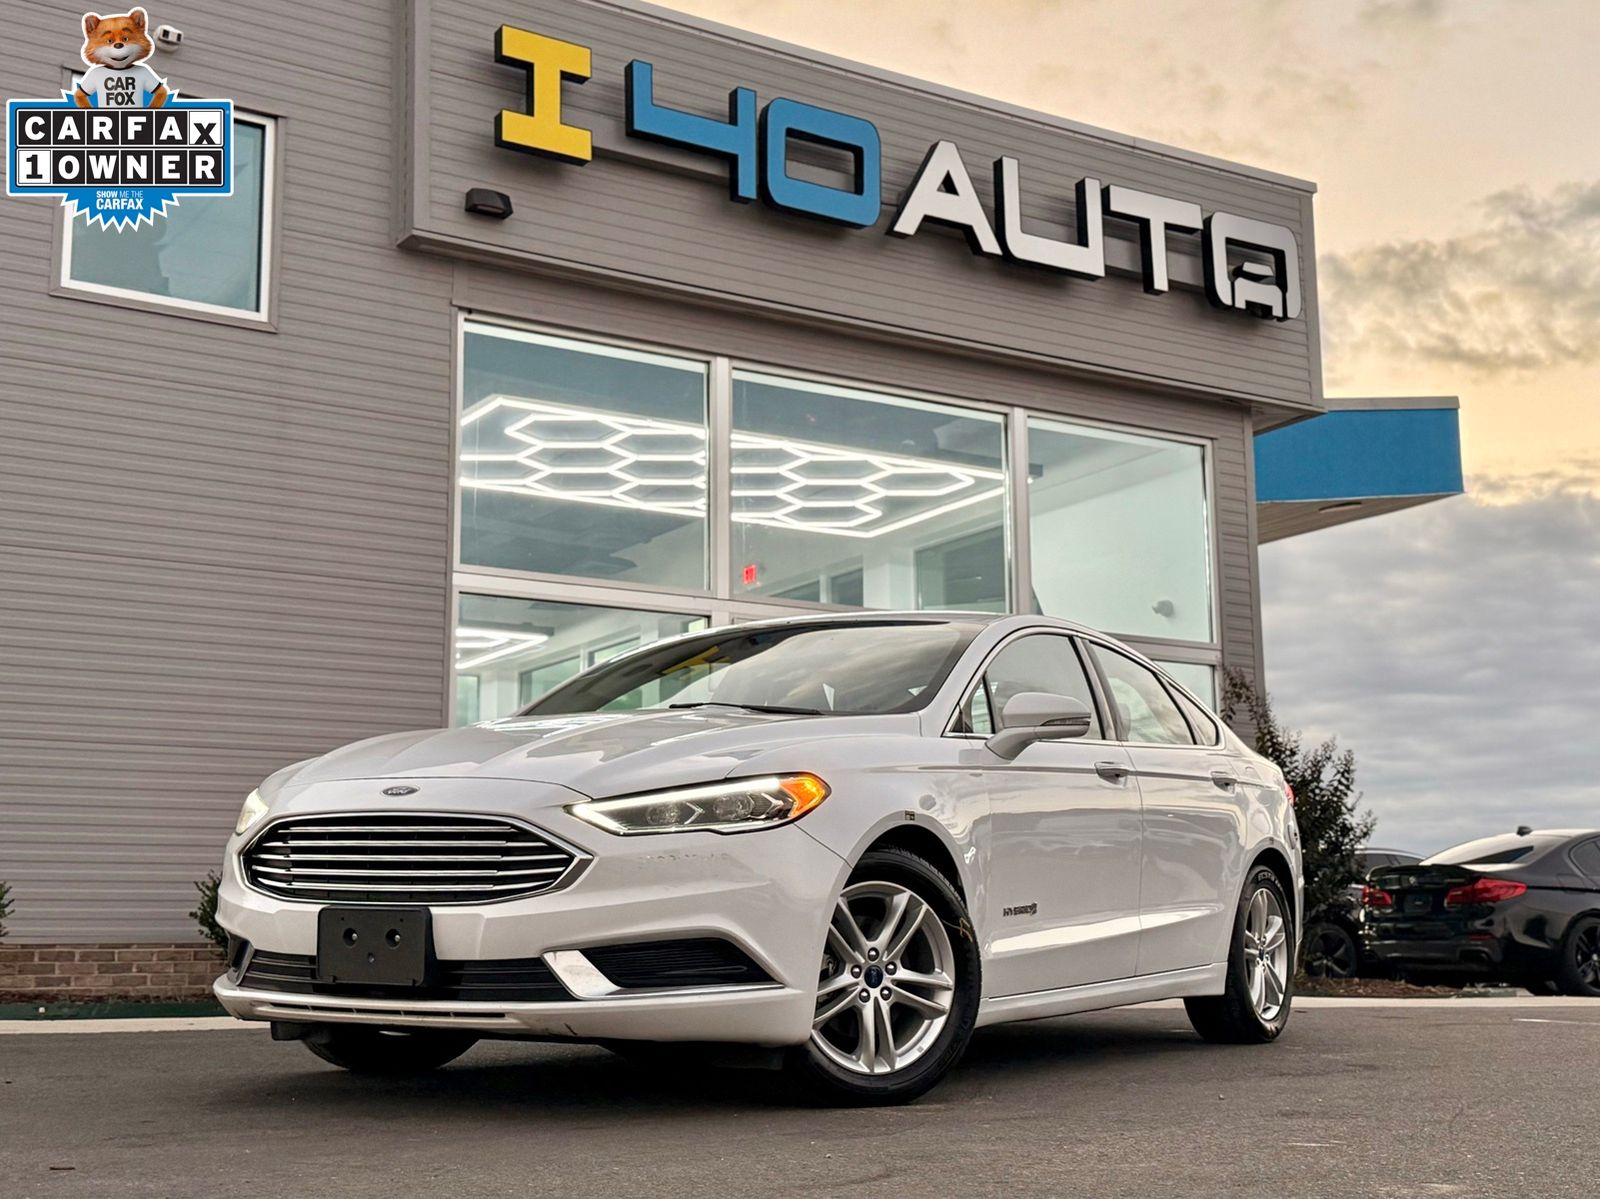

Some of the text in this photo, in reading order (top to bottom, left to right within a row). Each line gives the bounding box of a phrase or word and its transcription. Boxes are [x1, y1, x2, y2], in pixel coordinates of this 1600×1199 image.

[96, 24, 881, 229] I 40 SHOW ME THE
